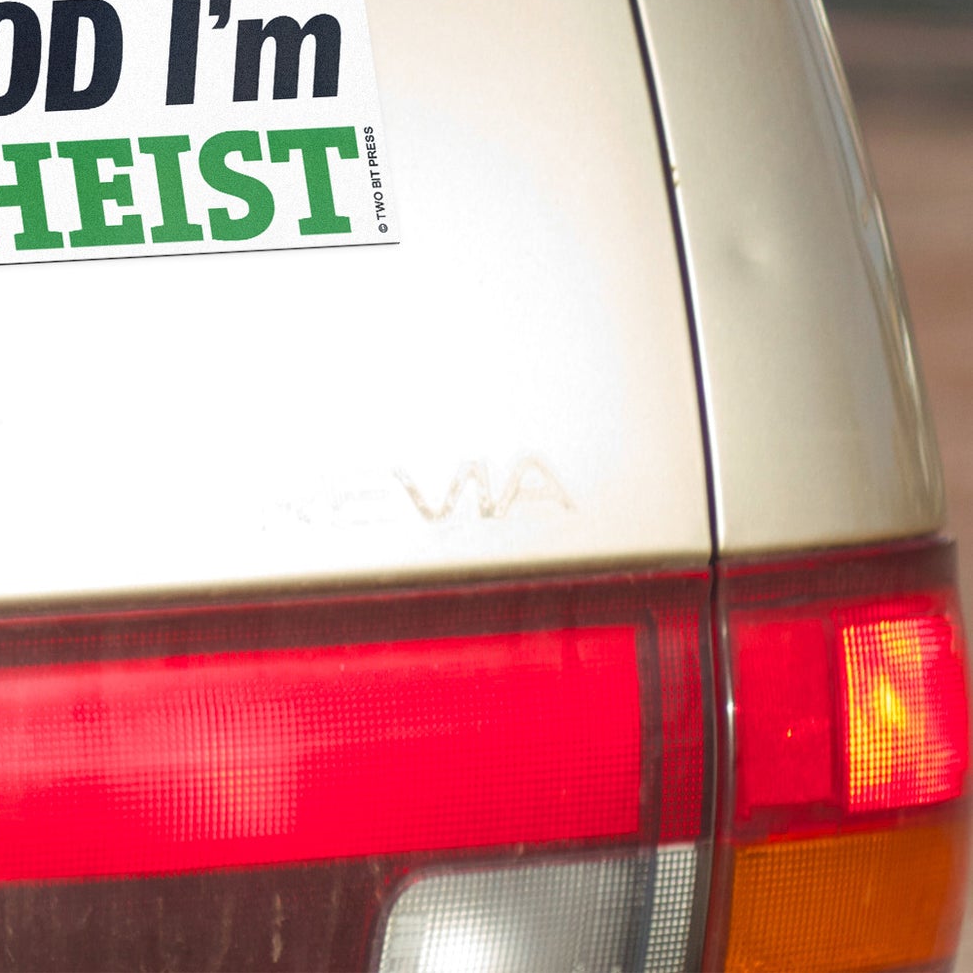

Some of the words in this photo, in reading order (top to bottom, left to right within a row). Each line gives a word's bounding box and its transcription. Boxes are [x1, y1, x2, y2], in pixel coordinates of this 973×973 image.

[363, 126, 379, 167] PRESS
[369, 170, 382, 188] BIT
[373, 191, 387, 220] TWO
